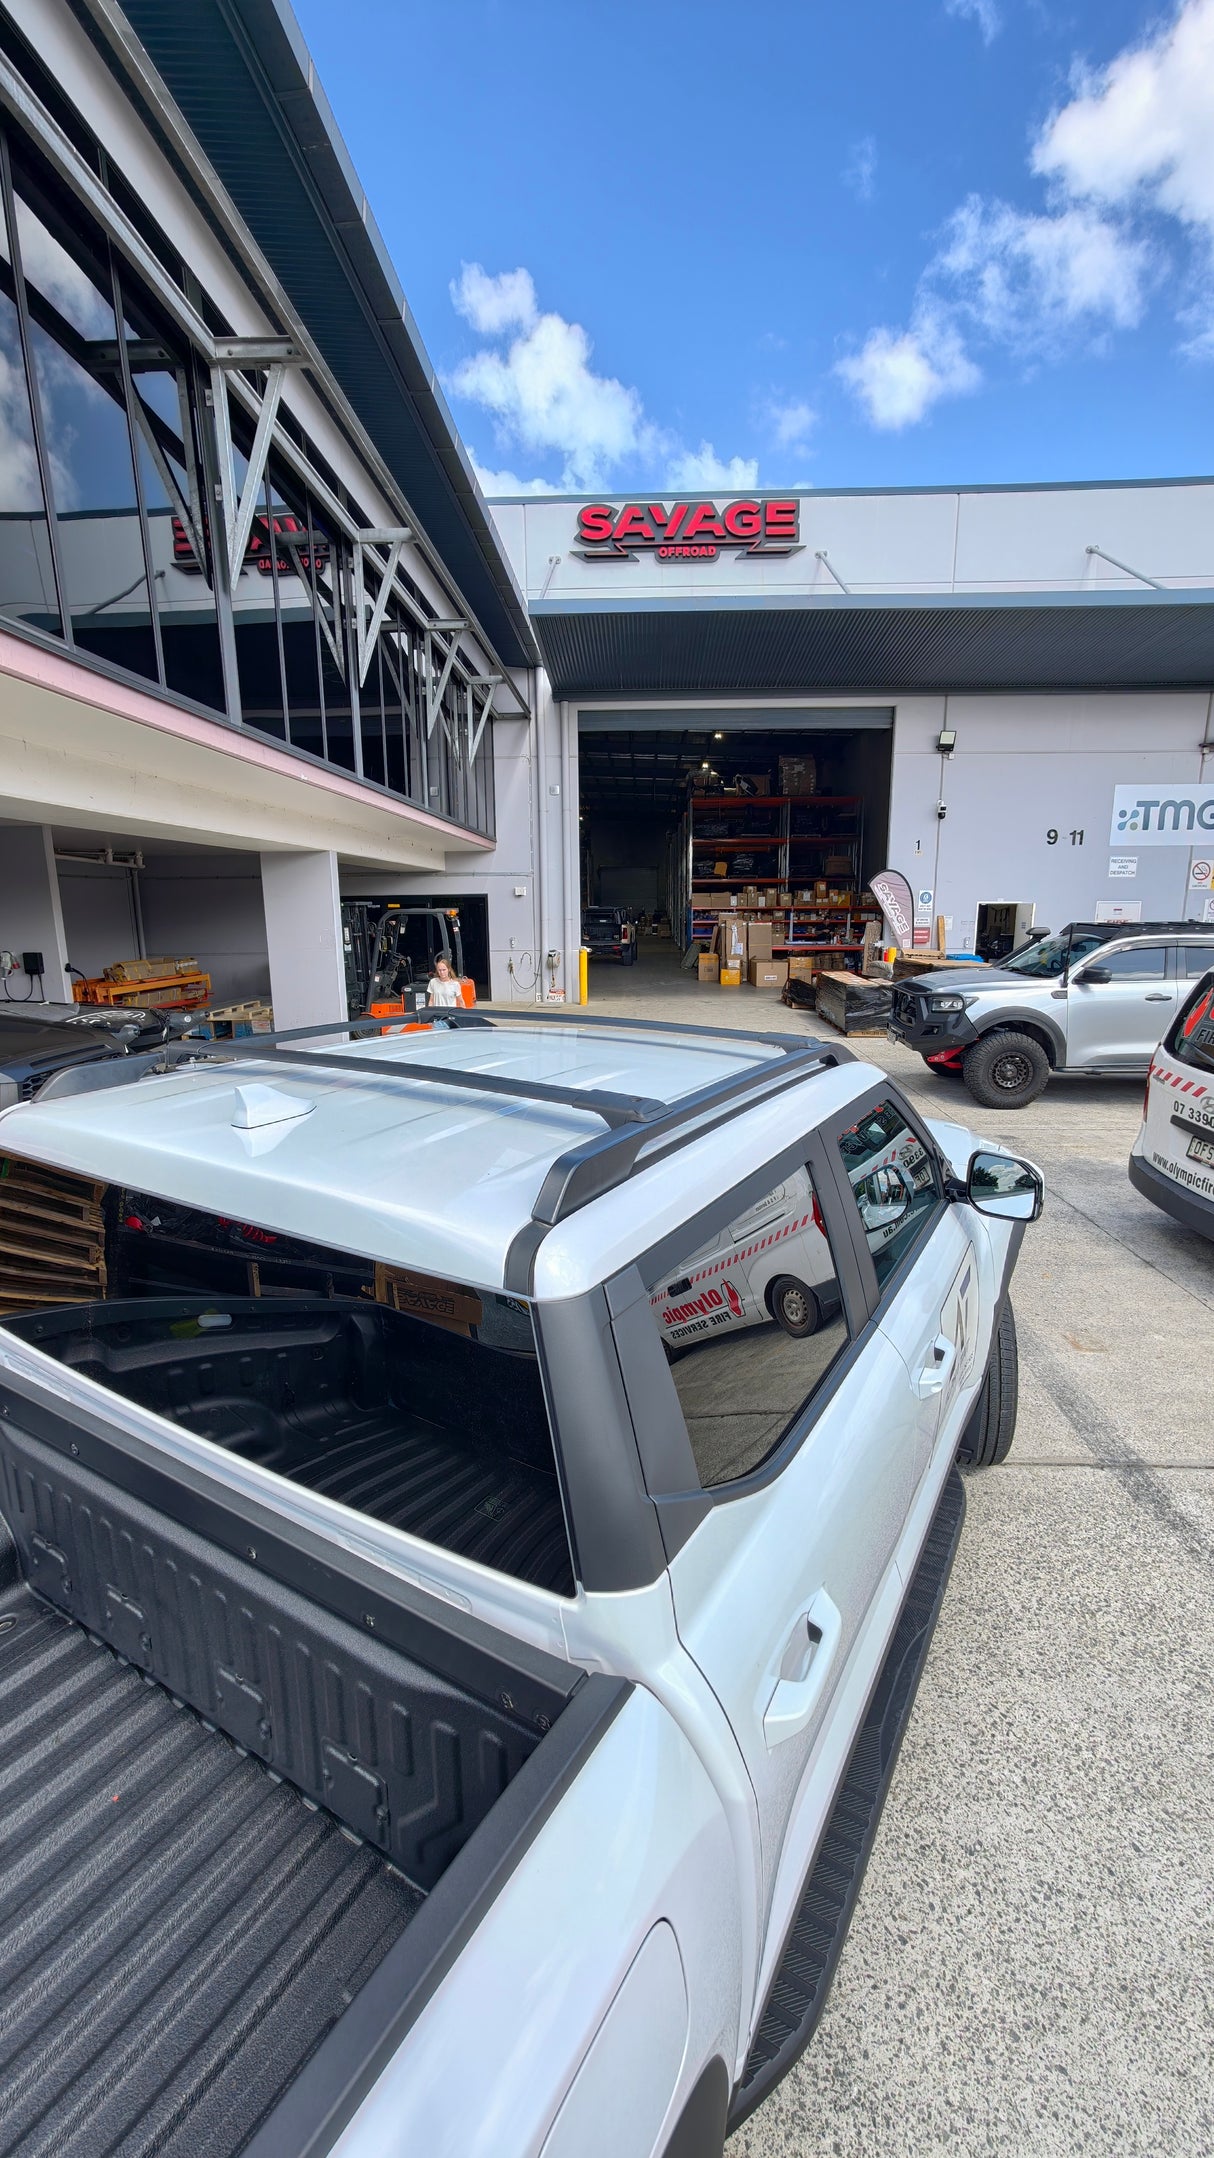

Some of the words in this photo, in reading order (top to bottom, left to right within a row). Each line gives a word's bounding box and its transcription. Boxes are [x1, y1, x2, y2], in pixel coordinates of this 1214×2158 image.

[580, 502, 797, 541] SAVAGE
[658, 545, 717, 559] OFFROAD
[1173, 1100, 1186, 1115] 07
